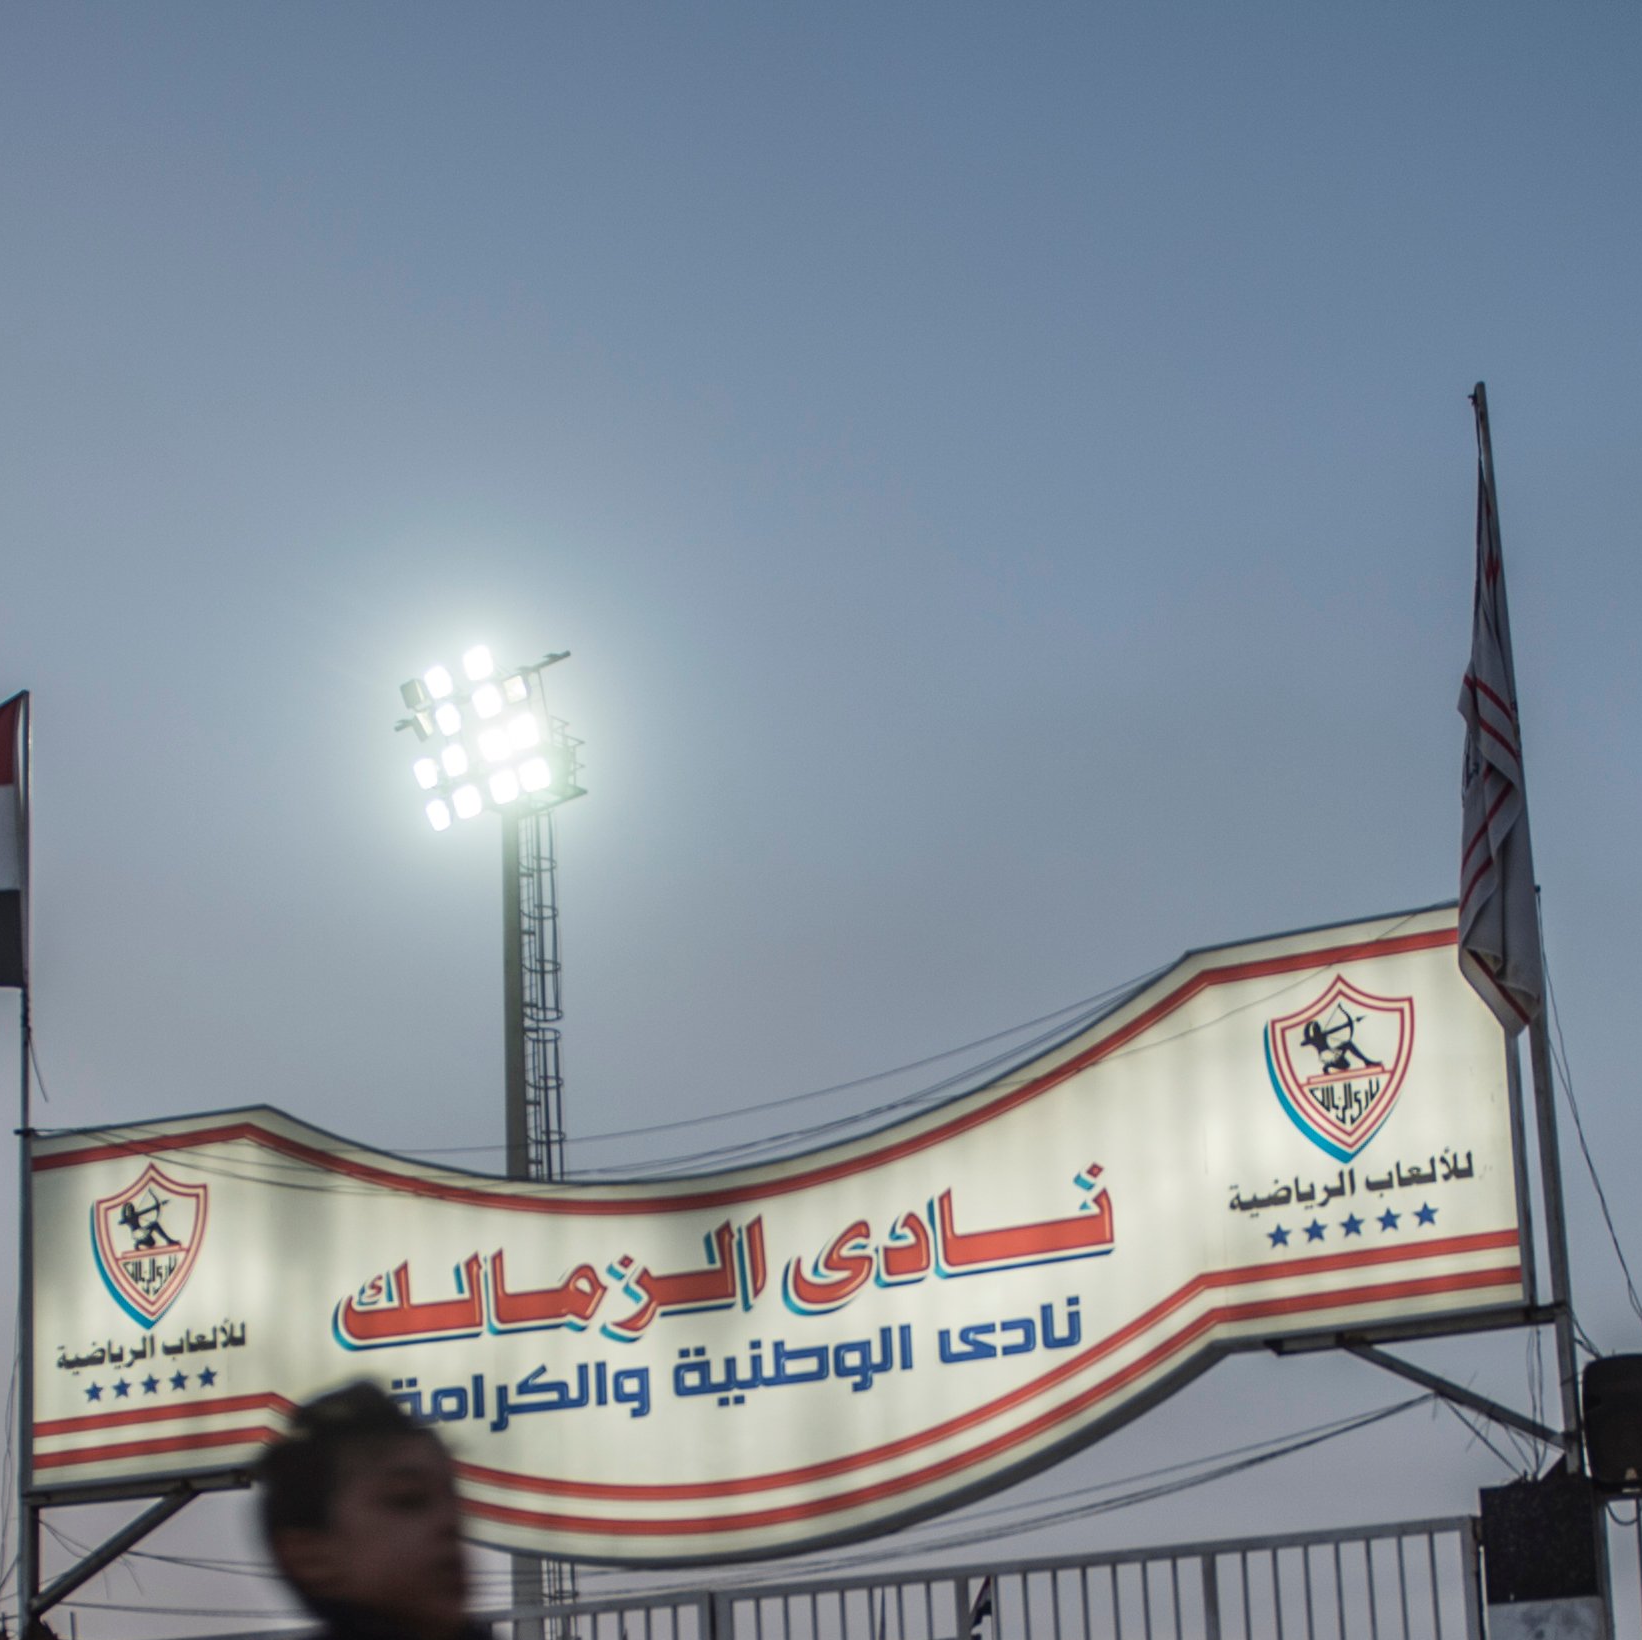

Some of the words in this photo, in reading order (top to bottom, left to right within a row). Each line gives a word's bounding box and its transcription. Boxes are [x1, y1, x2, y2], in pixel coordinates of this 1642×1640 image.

[1229, 1167, 1356, 1218] الرياضية
[332, 1214, 765, 1351] الزمالك
[56, 1333, 155, 1375] الرياضية
[672, 1323, 914, 1406] الوطنية
[387, 1360, 651, 1433] والكرامة
